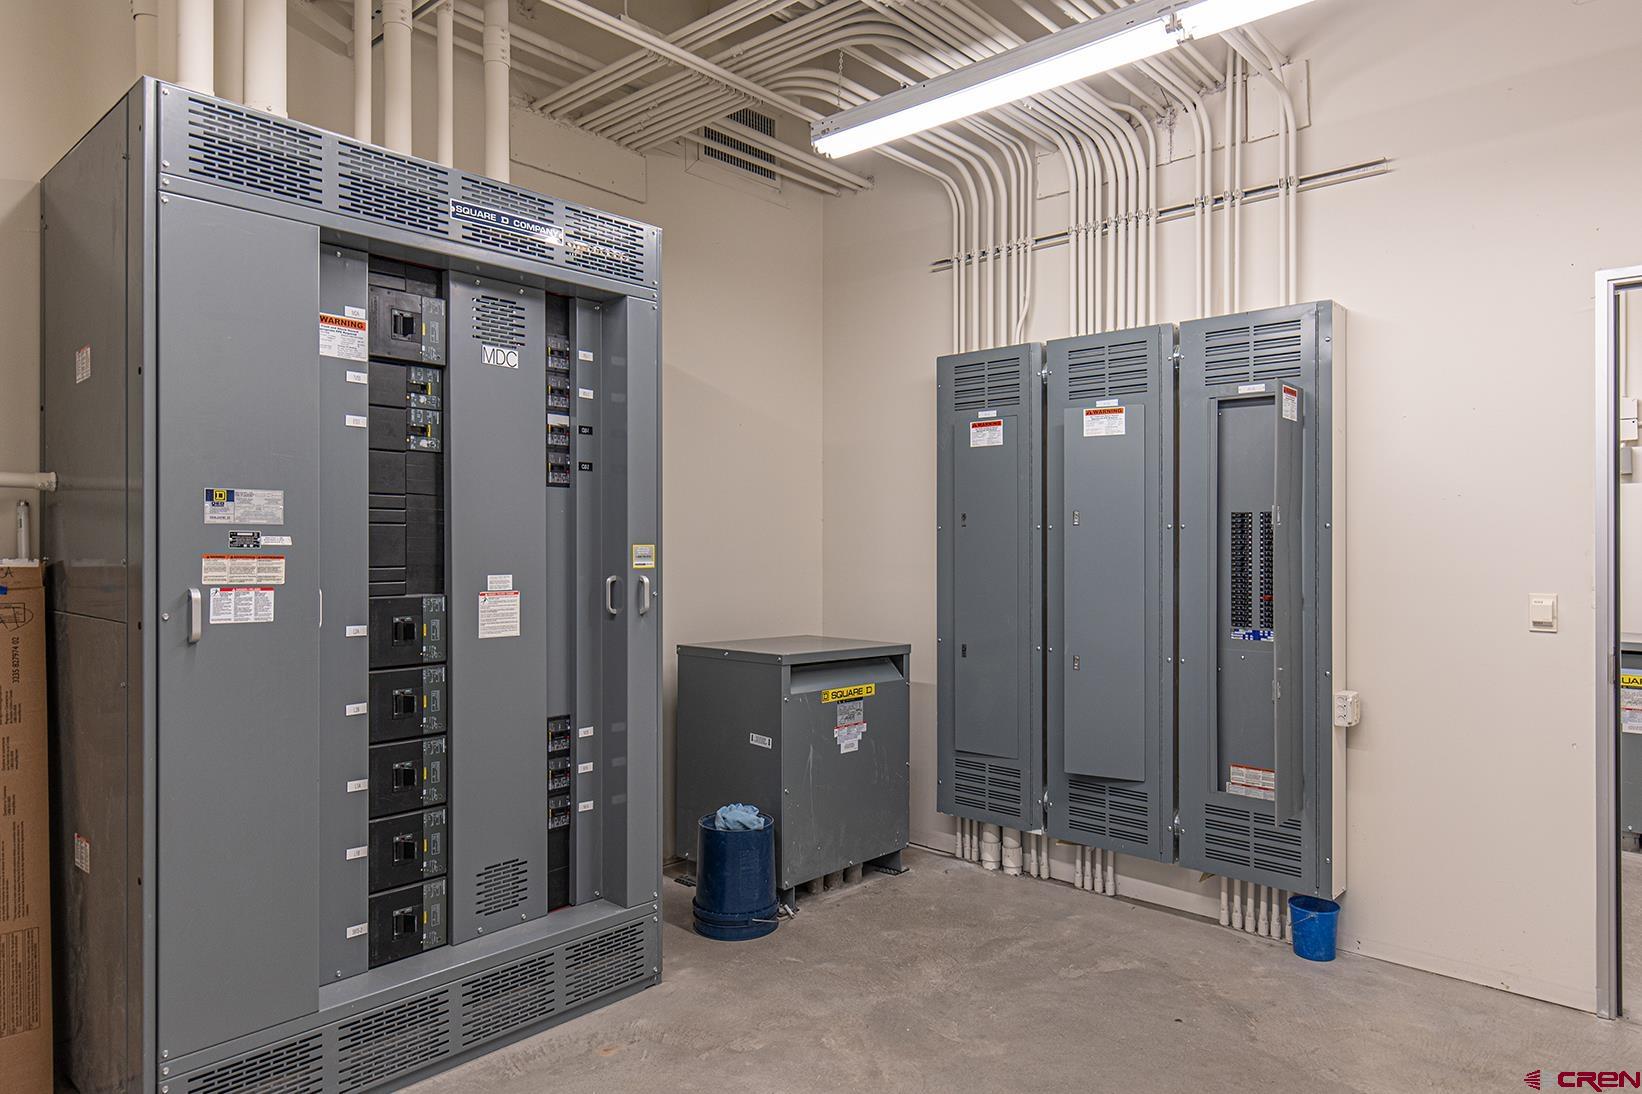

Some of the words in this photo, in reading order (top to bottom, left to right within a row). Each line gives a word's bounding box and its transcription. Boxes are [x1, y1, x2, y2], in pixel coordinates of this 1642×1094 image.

[455, 204, 497, 222] SQUARE
[501, 216, 509, 225] D
[513, 219, 561, 238] COMPANY
[320, 315, 363, 329] WARNING
[482, 346, 518, 368] MDC
[831, 687, 863, 700] SQUARE
[866, 685, 873, 694] D
